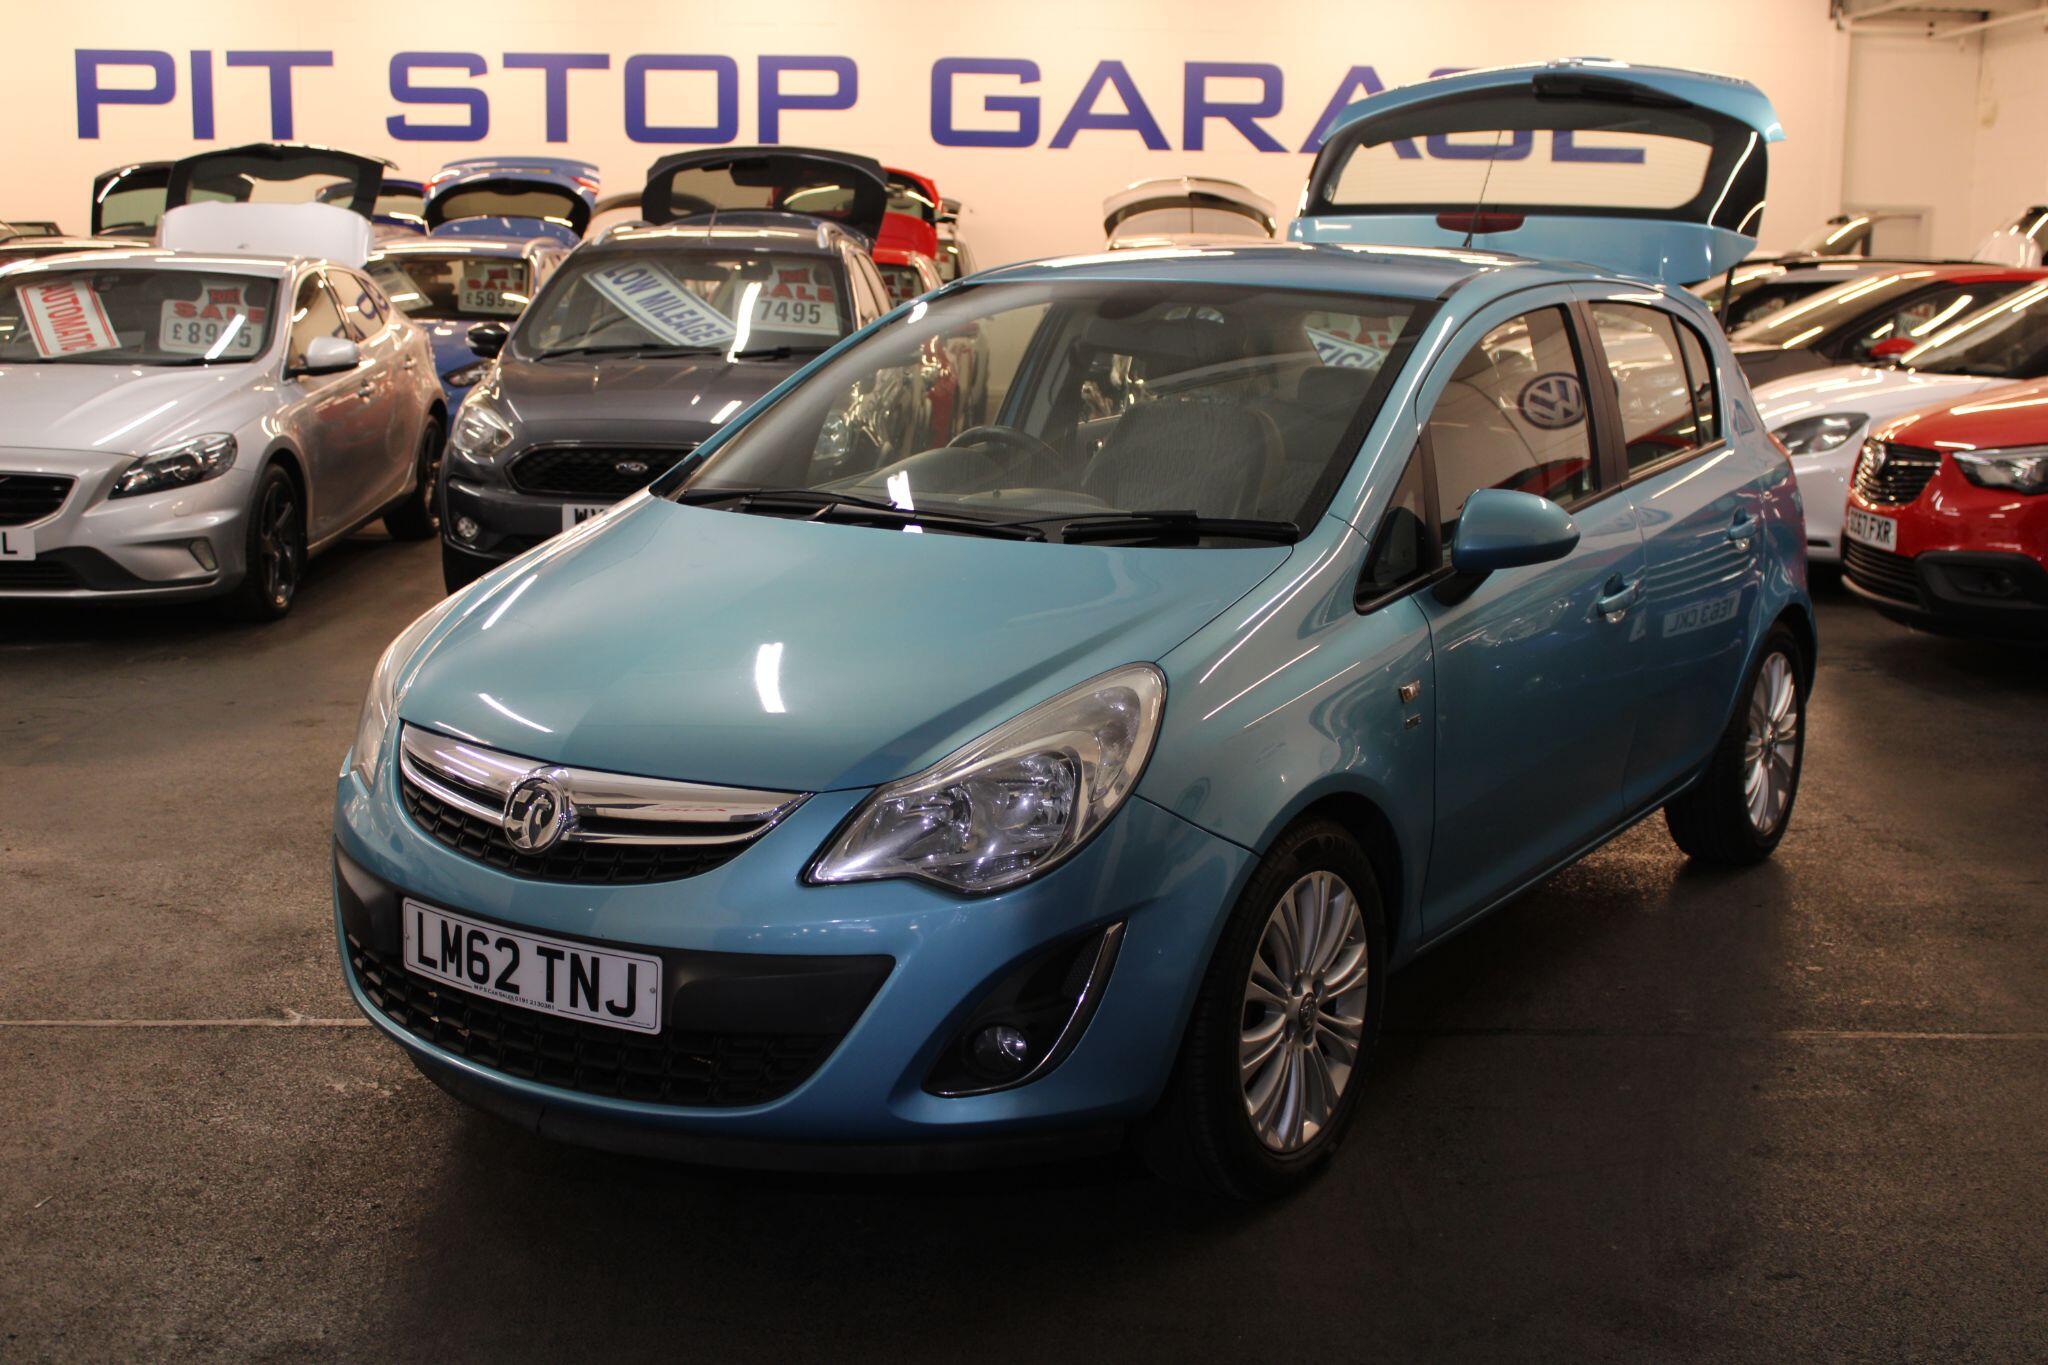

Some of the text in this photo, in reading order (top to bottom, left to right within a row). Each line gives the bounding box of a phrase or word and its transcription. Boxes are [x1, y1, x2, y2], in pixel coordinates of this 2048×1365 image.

[75, 49, 333, 140] PIT
[386, 51, 858, 144] STOP
[173, 321, 252, 349] £895
[603, 263, 726, 341] LOW MILEAGE
[418, 912, 637, 1018] LM62 TNJ
